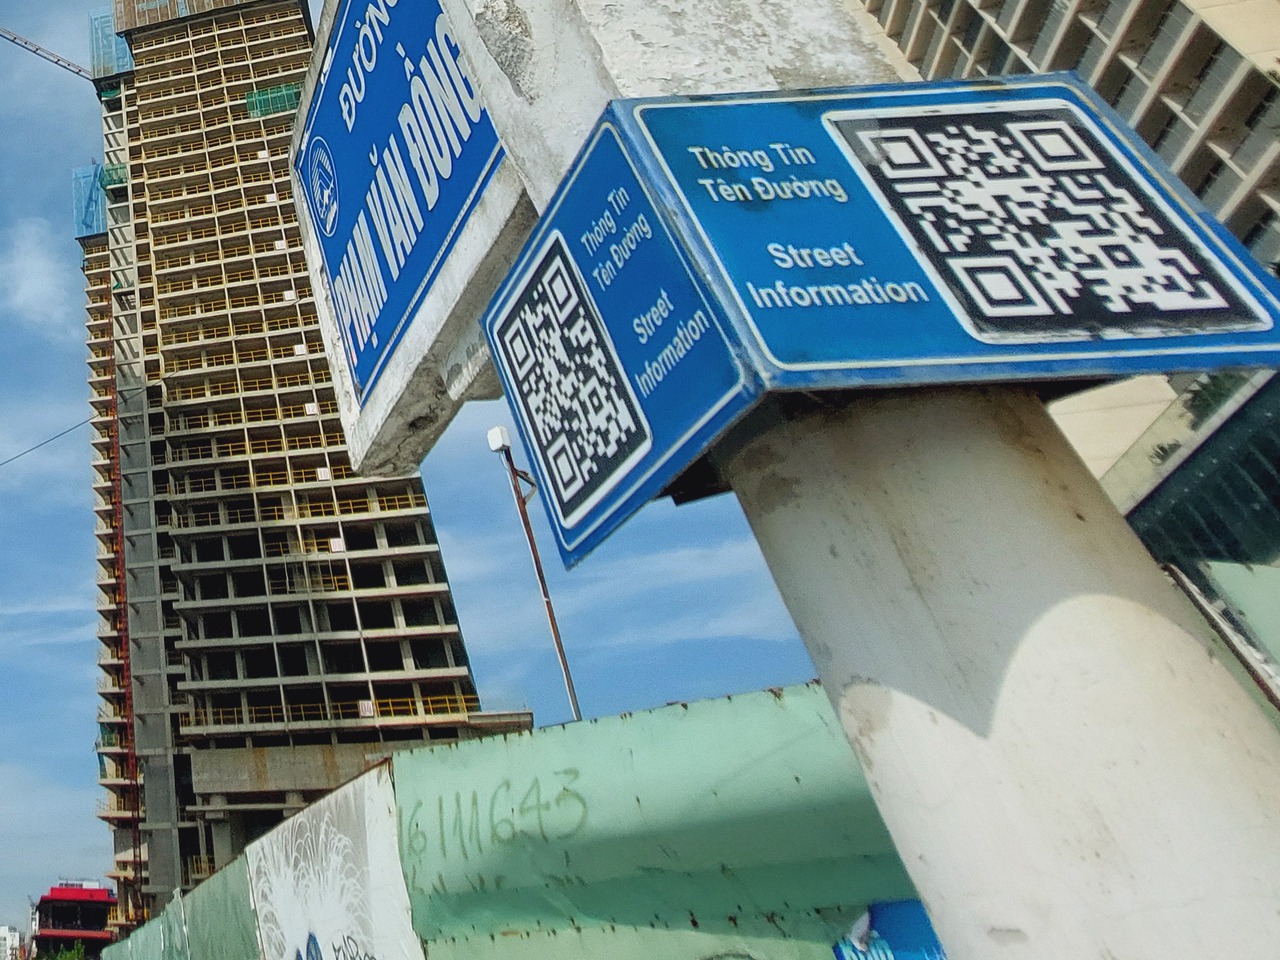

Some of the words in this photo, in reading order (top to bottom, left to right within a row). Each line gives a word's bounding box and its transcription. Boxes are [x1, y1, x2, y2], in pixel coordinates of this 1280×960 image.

[687, 145, 775, 172] Thông
[769, 143, 817, 165] Tin
[333, 209, 388, 367] PHẠM
[366, 134, 422, 281] VĂN
[396, 13, 486, 211] ĐỒNG
[697, 178, 753, 202] Tên
[751, 175, 849, 203] Đường
[580, 209, 617, 257] Thông
[607, 186, 631, 216] Tin
[592, 257, 617, 291] Tên
[609, 213, 653, 269] Đường
[767, 242, 864, 269] Street
[632, 288, 674, 344] Street
[745, 277, 930, 308] Information
[634, 309, 710, 398] Information
